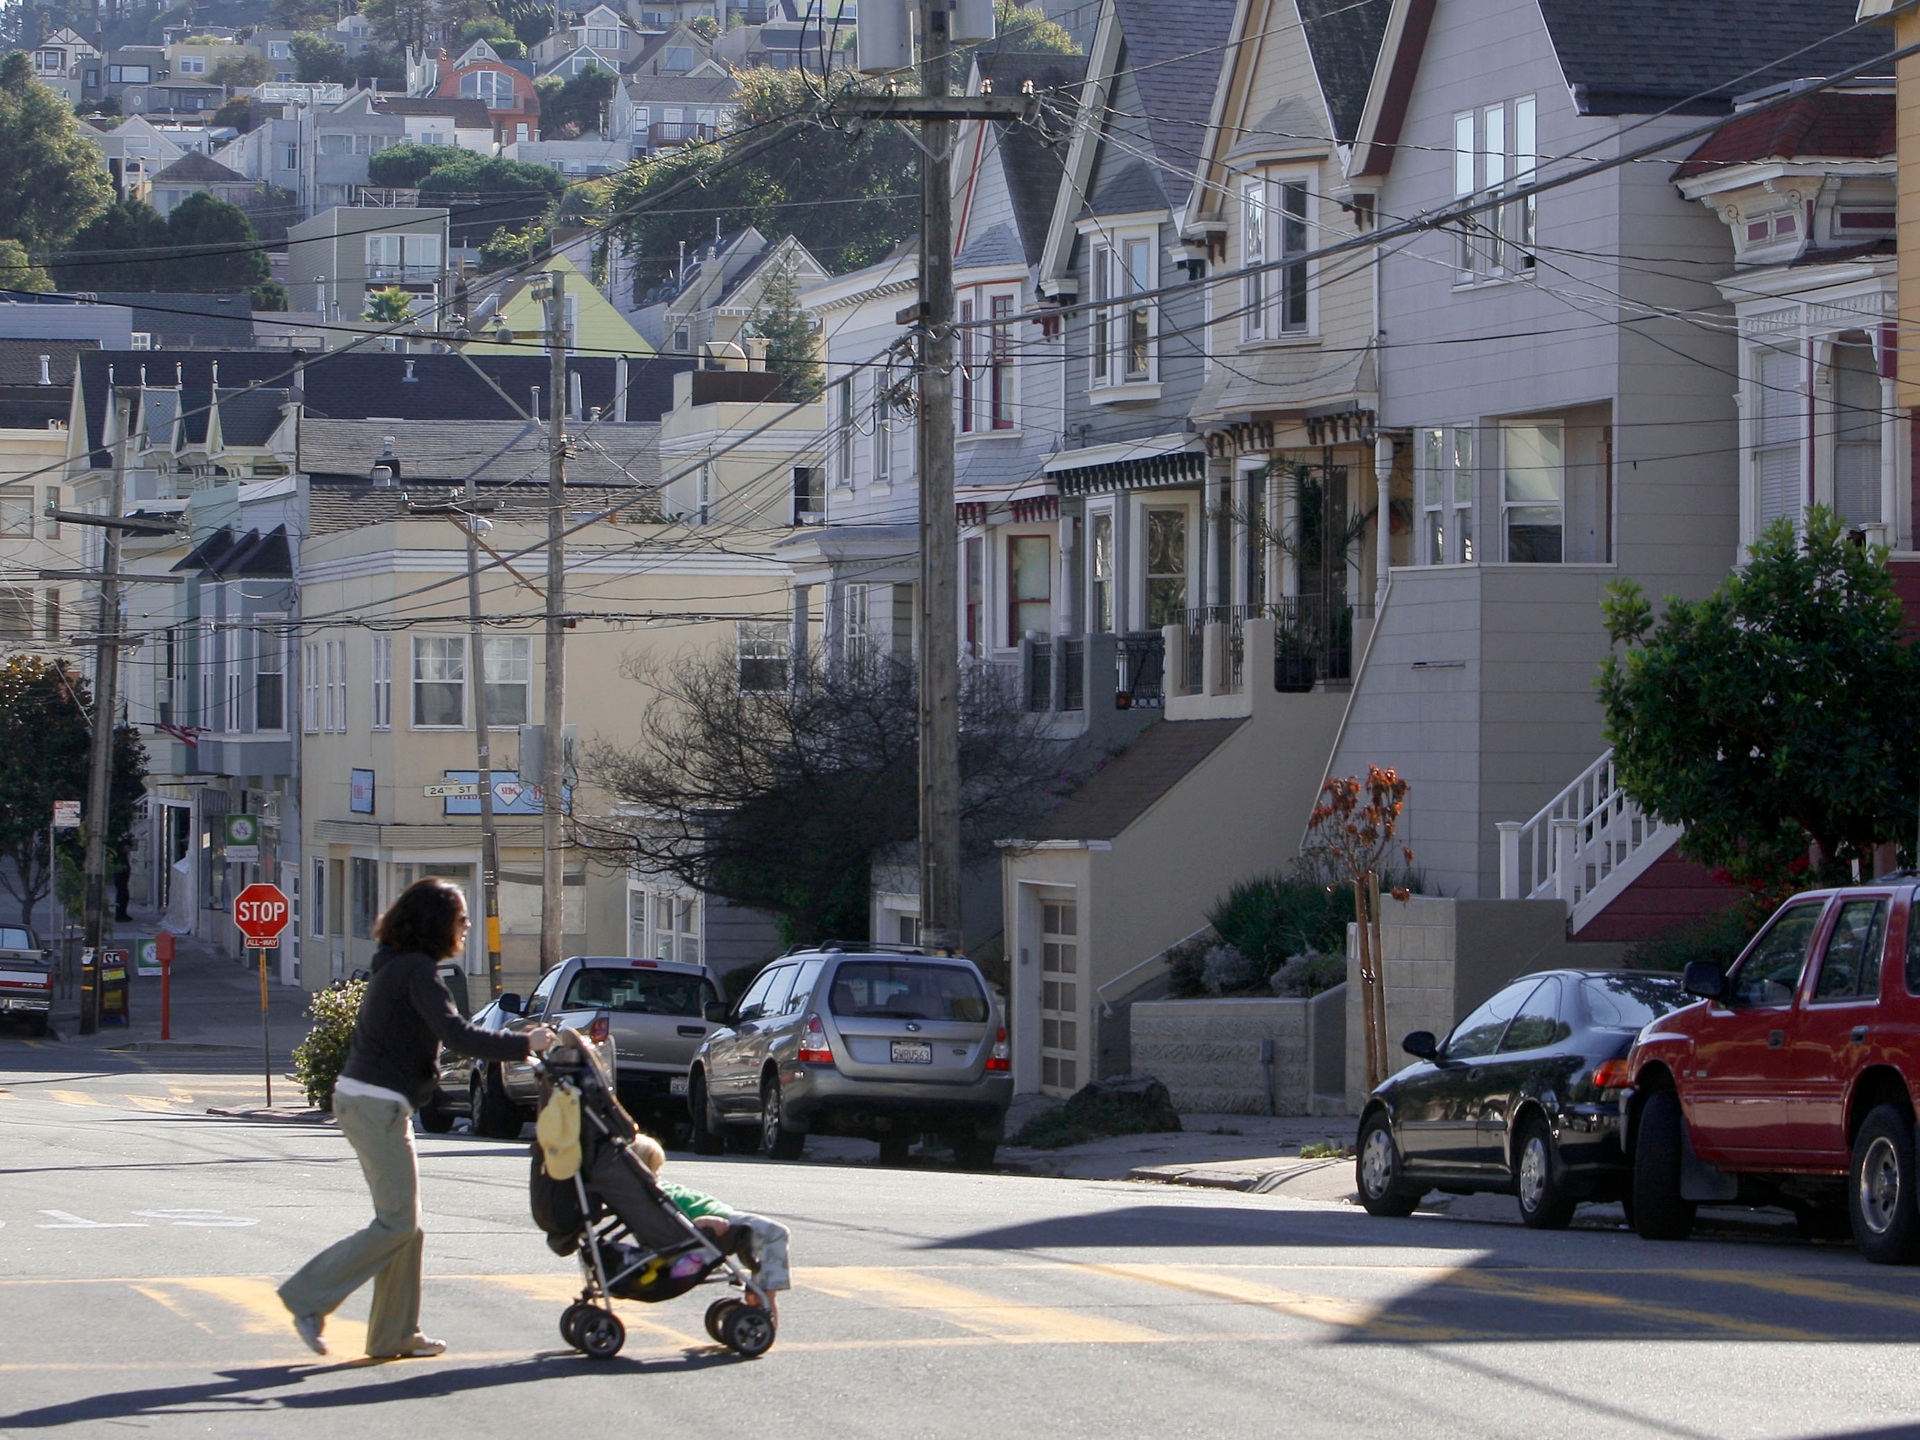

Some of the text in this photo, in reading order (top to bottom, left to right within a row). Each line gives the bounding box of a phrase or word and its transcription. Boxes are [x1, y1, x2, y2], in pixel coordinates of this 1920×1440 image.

[430, 785, 472, 795] 24TH ST
[238, 901, 285, 921] STOP
